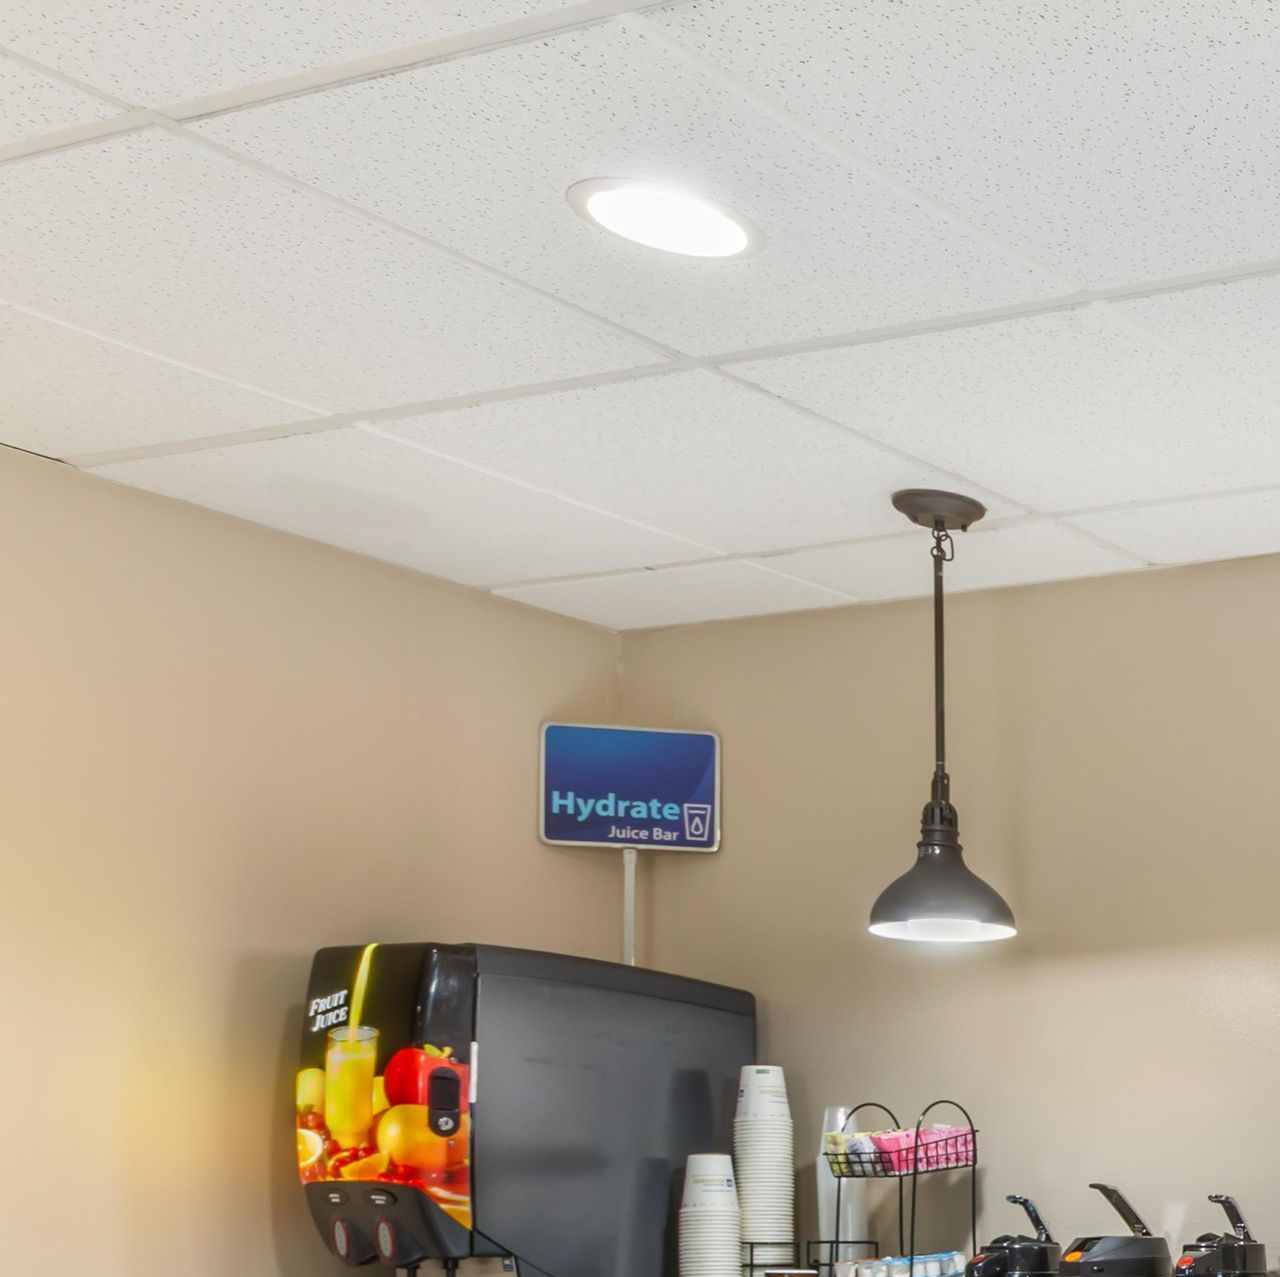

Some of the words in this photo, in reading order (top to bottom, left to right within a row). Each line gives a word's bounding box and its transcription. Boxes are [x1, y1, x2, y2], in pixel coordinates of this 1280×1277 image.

[551, 790, 681, 822] Hydrate
[608, 825, 649, 840] Juice
[652, 827, 680, 841] Bar
[309, 989, 349, 1017] FRUIT
[310, 1006, 349, 1032] JUICE
